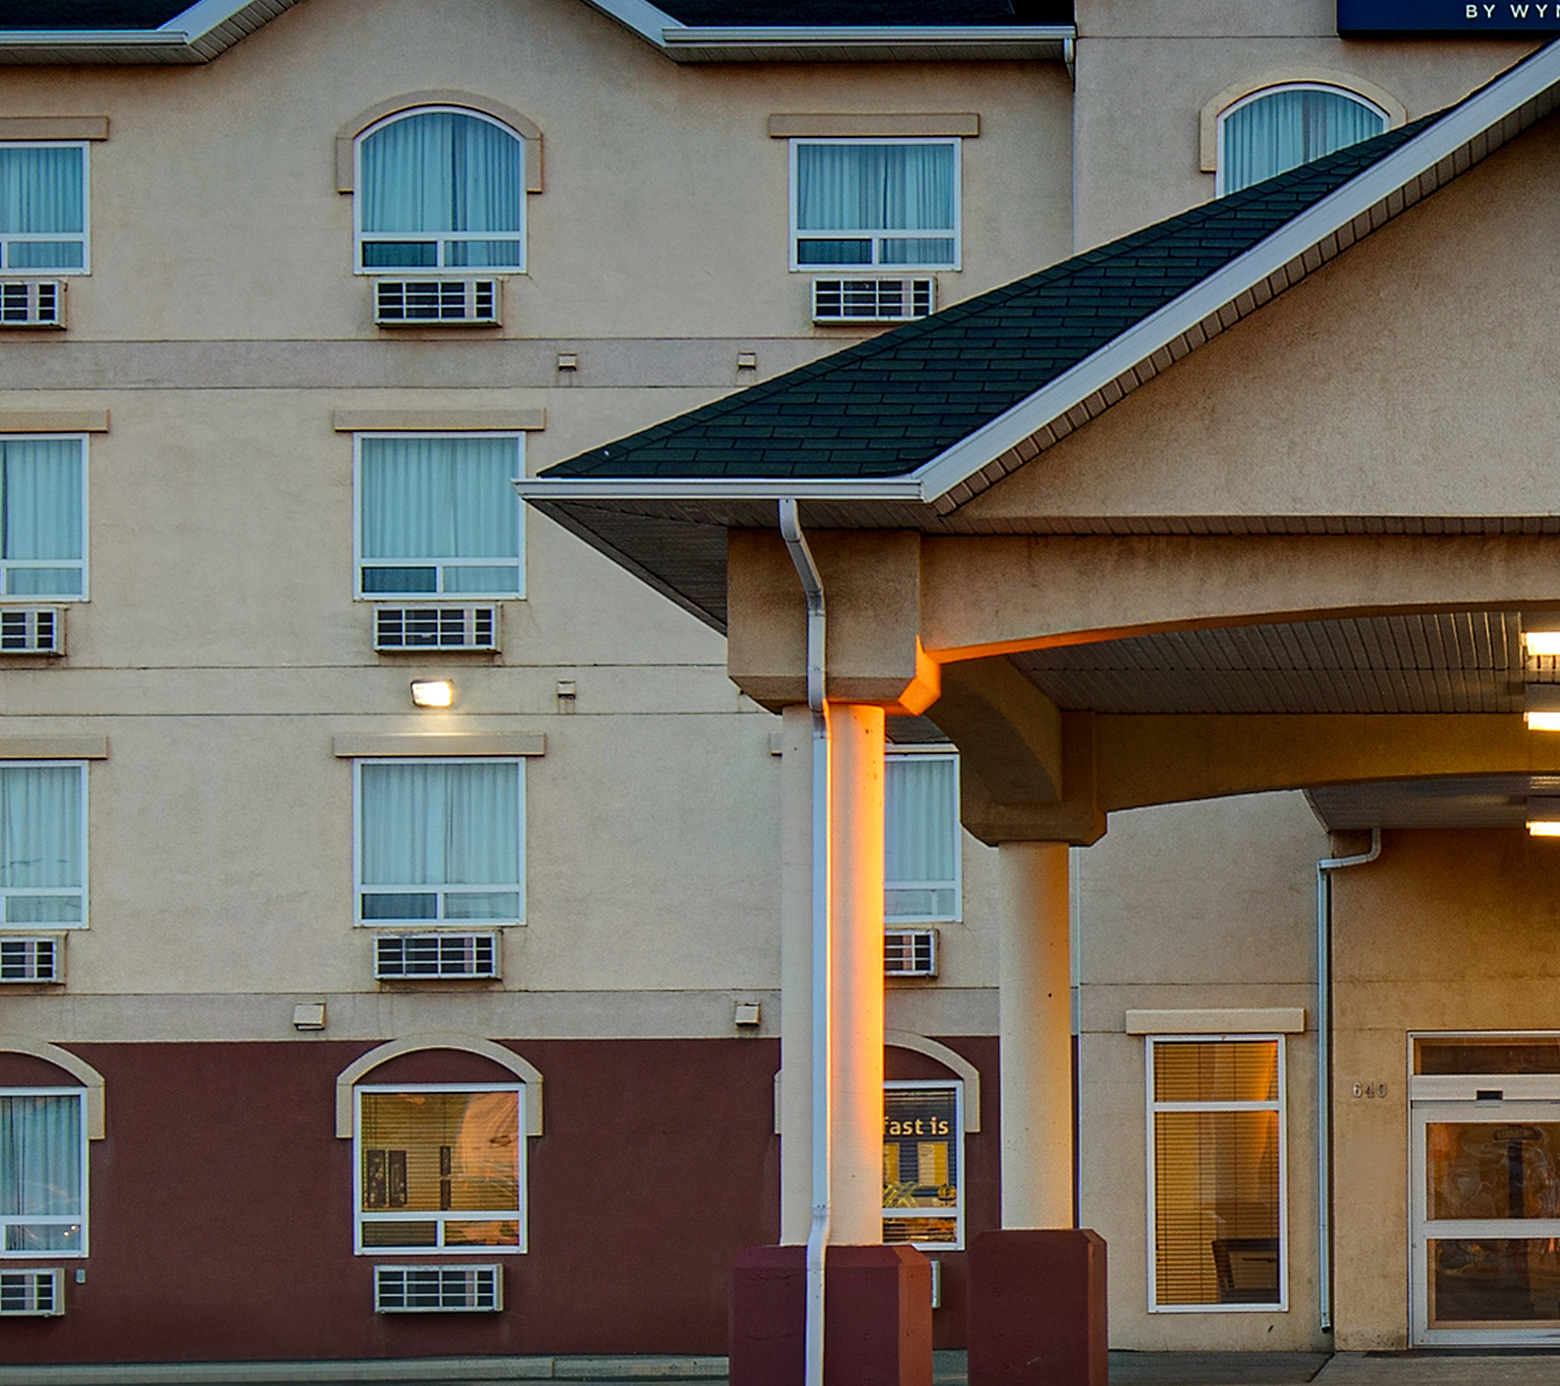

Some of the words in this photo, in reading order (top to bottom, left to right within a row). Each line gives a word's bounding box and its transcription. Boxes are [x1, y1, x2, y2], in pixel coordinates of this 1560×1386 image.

[1465, 4, 1496, 19] BY
[1353, 1082, 1388, 1098] 640
[930, 1116, 949, 1135] is
